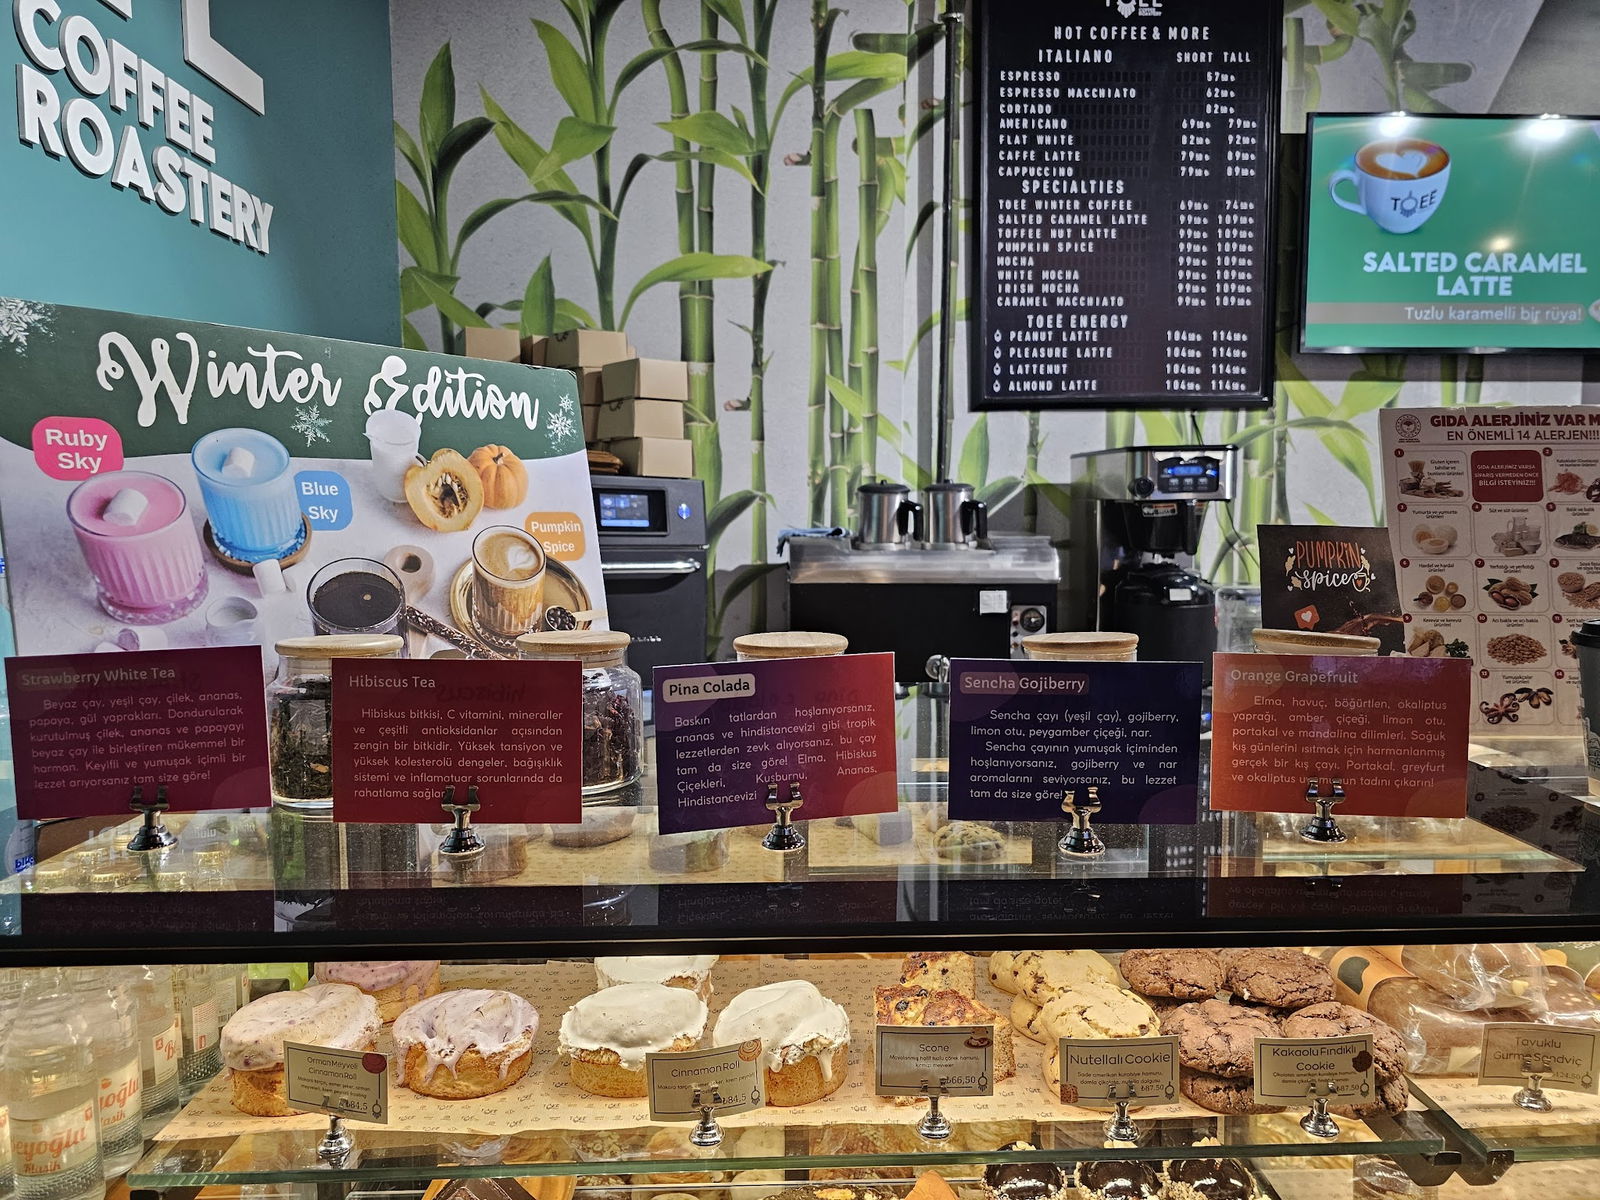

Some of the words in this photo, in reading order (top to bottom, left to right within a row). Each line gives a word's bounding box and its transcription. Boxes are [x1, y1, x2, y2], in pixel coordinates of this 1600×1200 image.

[1055, 27, 1082, 40] HOT
[1090, 27, 1147, 40] COFFEE
[1153, 27, 1160, 40] &
[1169, 27, 1210, 40] MORE
[1039, 49, 1113, 63] ITALIANO
[1177, 52, 1212, 63] SHORT
[1223, 52, 1251, 63] TALL
[1001, 71, 1060, 81] ESPRESSO
[12, 0, 216, 165] COFFEE
[1000, 88, 1060, 98] ESPRESSO
[1068, 88, 1136, 98] MACCHIATO
[1000, 104, 1051, 114] CORTADO
[1000, 119, 1067, 129] AMERICANO
[999, 135, 1027, 145] FLAT
[1037, 135, 1074, 145] WHITE
[15, 63, 274, 255] ROASTERY
[1045, 151, 1080, 162] LATTE
[999, 167, 1073, 177] CAPPUCCINO
[1022, 180, 1124, 193] SPECIALTIES
[1035, 200, 1080, 210] WINTER
[1088, 200, 1132, 210] COFFEE
[998, 215, 1042, 224] SALTED
[1050, 215, 1101, 224] CARAMEL
[1112, 215, 1147, 224] LATTE
[998, 229, 1041, 238] TOFFEE
[1051, 229, 1071, 238] NUT
[1081, 229, 1116, 239] LATTE
[998, 242, 1049, 252] PUMPKIN
[1058, 242, 1094, 252] SPICE
[997, 257, 1034, 266] MOCHA
[1363, 252, 1457, 272] SALTED
[1465, 252, 1587, 273] CARAMEL
[998, 270, 1032, 280] WHITE
[1042, 270, 1079, 280] MOCHA
[998, 284, 1033, 293] IRISH
[1042, 284, 1079, 293] MOCHA
[1437, 276, 1512, 296] LATTE
[997, 297, 1047, 306] CARAMEL
[1057, 297, 1124, 307] MACCHIATO
[1405, 306, 1443, 320] Tuzlu
[1450, 306, 1516, 321] karamelli
[1546, 307, 1581, 323] rüya!
[1071, 315, 1128, 328] ENERGY
[1010, 331, 1052, 341] PEANUT
[1063, 331, 1097, 341] LATTE
[1009, 348, 1068, 358] PLEASURE
[1077, 348, 1112, 358] LATTE
[1009, 364, 1067, 374] LATTENUT
[96, 332, 342, 427] Winter
[363, 355, 538, 430] Edition
[1009, 381, 1052, 391] ALMOND
[1062, 381, 1096, 391] LATTE
[1431, 415, 1469, 427] GIDA
[1472, 412, 1550, 426] ALERJİNİZ
[1554, 414, 1585, 426] VAR
[45, 428, 107, 451] Ruby
[1448, 431, 1463, 440] EN
[1469, 428, 1513, 440] ÖNEMLİ
[1517, 431, 1530, 440] 14
[1535, 430, 1599, 440] ALERJEN!!!
[57, 451, 102, 474] Sky
[301, 481, 338, 496] Blue
[308, 505, 338, 522] Sky
[531, 521, 581, 535] Pumpkin
[543, 540, 575, 554] Spice
[1295, 569, 1355, 591] spice
[22, 672, 100, 686] Strawberry
[104, 670, 147, 682] White
[151, 668, 175, 679] Tea
[350, 676, 408, 687] Hibiscus
[412, 677, 435, 688] Tea
[1231, 670, 1281, 685] Orange
[1285, 671, 1358, 685] Grapefruit
[669, 684, 699, 696] Pina
[703, 679, 750, 693] Colada
[965, 677, 1015, 688] Sencha
[1019, 677, 1085, 693] Gojiberry
[354, 726, 365, 734] ve
[379, 726, 408, 736] çeşitli
[422, 726, 497, 735] antioksidanlar
[512, 726, 562, 737] açısından
[676, 733, 714, 743] ananas
[741, 723, 815, 737] hindistancevizi
[822, 721, 840, 732] gibi
[847, 719, 875, 730] tropik
[1233, 728, 1278, 738] portakal
[1282, 729, 1294, 737] ve
[1299, 729, 1356, 739] mandalina
[1411, 730, 1446, 742] Soğuk
[354, 742, 388, 752] zengin
[395, 741, 408, 750] bir
[458, 742, 495, 751] Yüksek
[501, 743, 545, 754] tansiyon
[550, 743, 562, 751] ve
[986, 742, 1026, 752] Sencha
[1031, 744, 1069, 754] çayının
[1074, 744, 1121, 754] yumuşak
[1126, 744, 1177, 754] içiminden
[34, 780, 66, 789] lezzet
[70, 777, 129, 788] arıyorsanız
[133, 774, 154, 784] tam
[158, 772, 179, 782] size
[183, 770, 210, 782] göre!
[355, 773, 389, 782] sistemi
[394, 774, 406, 782] ve
[411, 773, 472, 783] inflamatuar
[477, 774, 543, 783] sorunlarında
[549, 774, 562, 783] da
[678, 791, 757, 807] Hindistancevizi
[970, 790, 991, 798] tam
[994, 789, 1007, 798] da
[1012, 790, 1031, 798] size
[1035, 789, 1062, 801] göre!
[920, 1044, 949, 1052] Scone
[1515, 1037, 1561, 1048] Tavuklu
[1273, 1048, 1318, 1056] Kakaolu
[1321, 1045, 1356, 1056] Fındıklı
[1070, 1055, 1122, 1065] Nutellalı
[1125, 1053, 1170, 1064] Cookie
[1494, 1051, 1532, 1061] Gurme
[1534, 1053, 1582, 1067] Sandviç
[671, 1065, 722, 1077] Cinnamon
[723, 1061, 740, 1070] Roll
[1296, 1062, 1335, 1070] Cookie
[309, 1067, 343, 1078] Cinnamon
